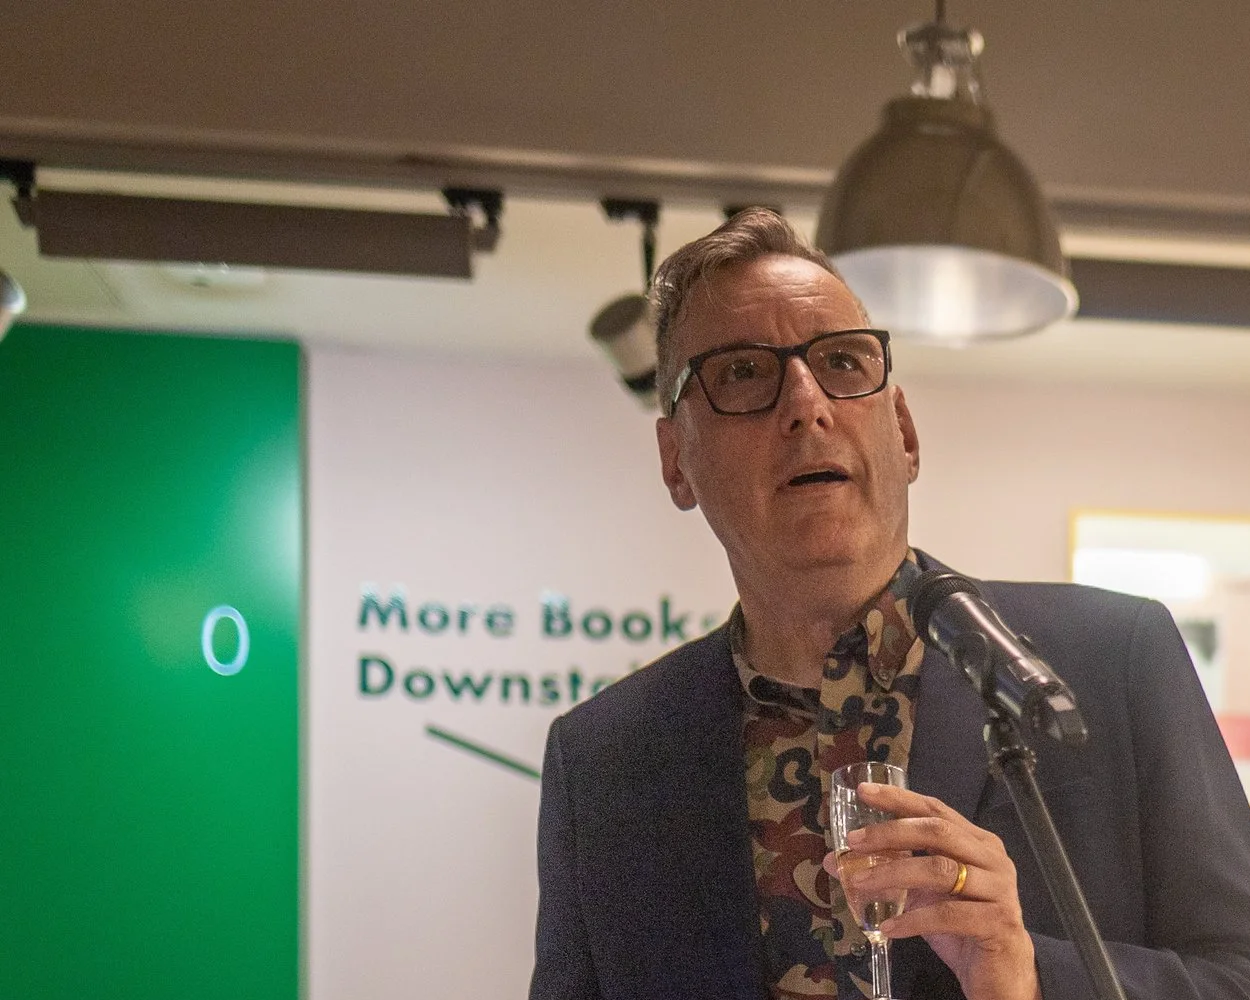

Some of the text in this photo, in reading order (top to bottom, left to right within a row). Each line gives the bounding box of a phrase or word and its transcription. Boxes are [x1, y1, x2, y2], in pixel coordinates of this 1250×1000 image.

[357, 588, 515, 637] More
[202, 606, 249, 676] 0
[357, 654, 638, 704] Downst
